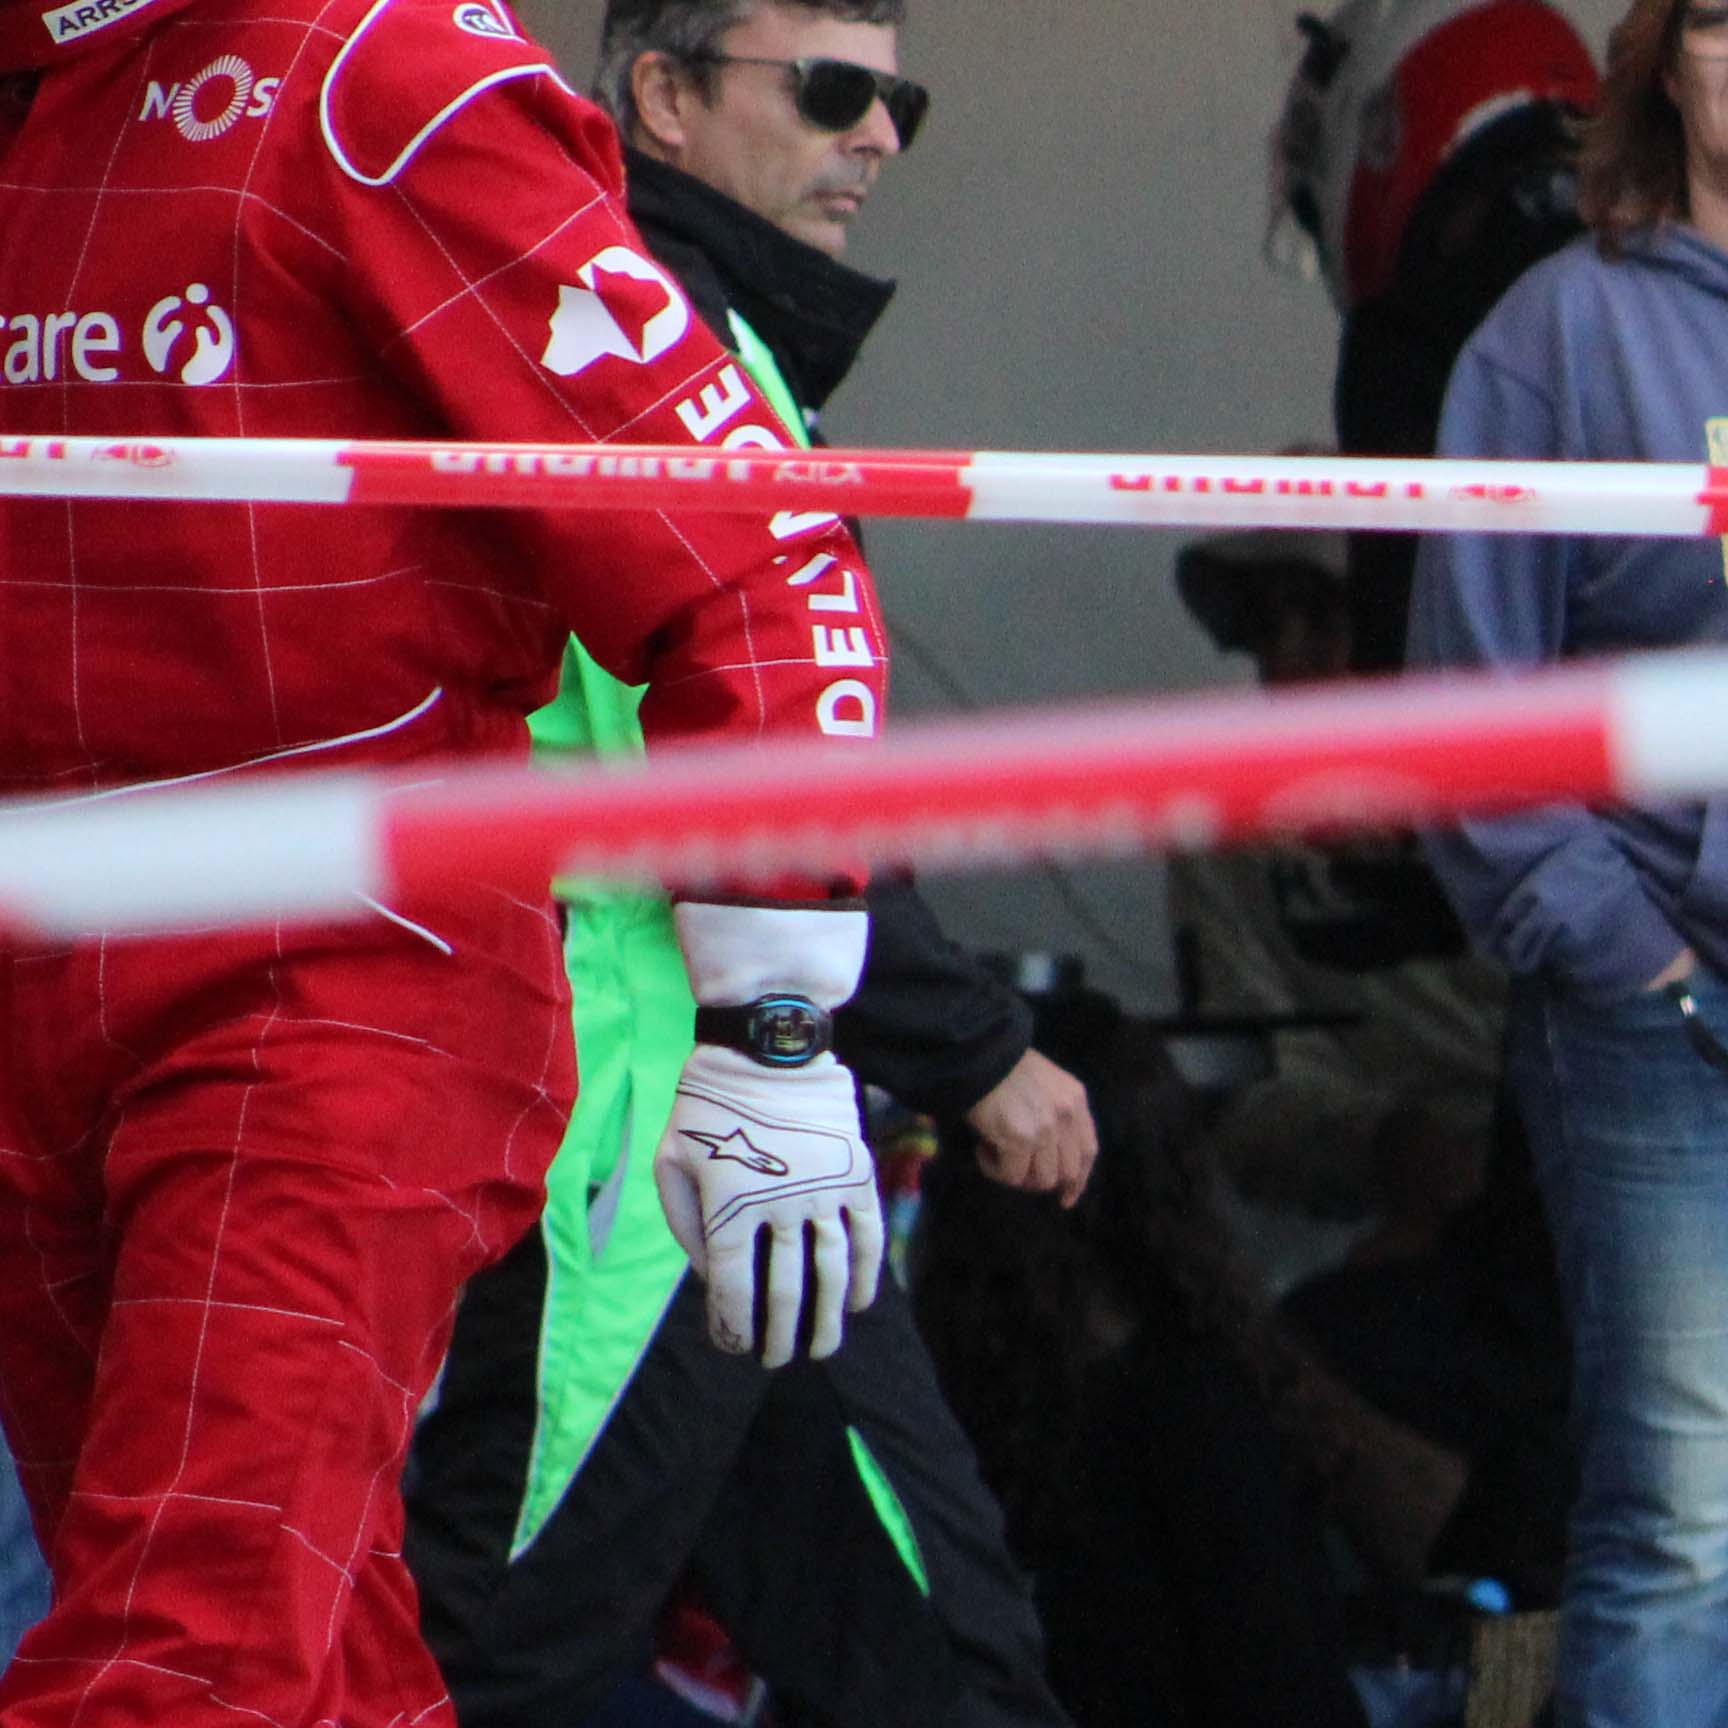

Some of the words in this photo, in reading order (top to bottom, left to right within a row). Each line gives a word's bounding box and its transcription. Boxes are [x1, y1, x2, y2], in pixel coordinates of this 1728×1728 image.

[57, 0, 141, 36] ARR
[138, 54, 282, 142] NOS
[0, 311, 122, 385] are
